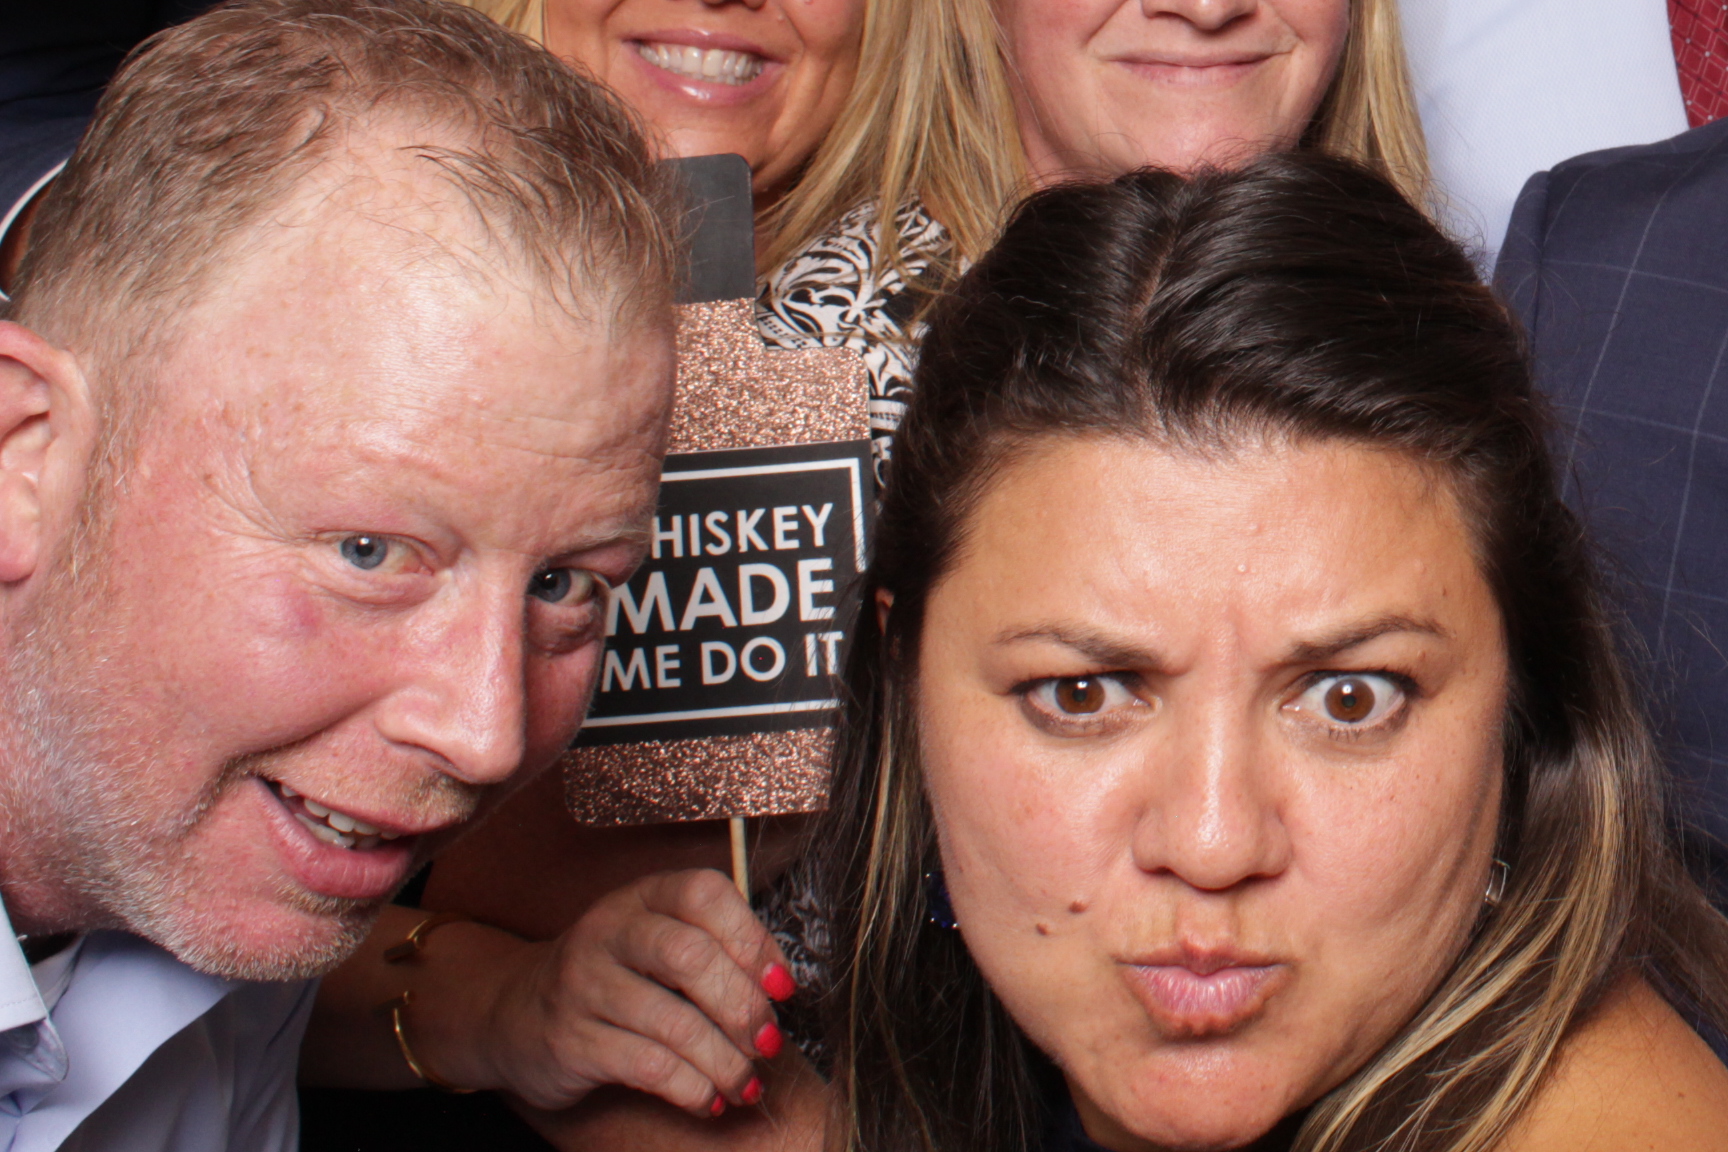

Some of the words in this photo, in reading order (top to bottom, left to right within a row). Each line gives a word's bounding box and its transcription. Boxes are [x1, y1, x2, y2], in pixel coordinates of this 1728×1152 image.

[651, 502, 834, 558] HISKEY
[605, 557, 836, 636] MADE
[601, 644, 682, 692] ME
[701, 636, 786, 686] DO
[805, 631, 844, 677] IT
